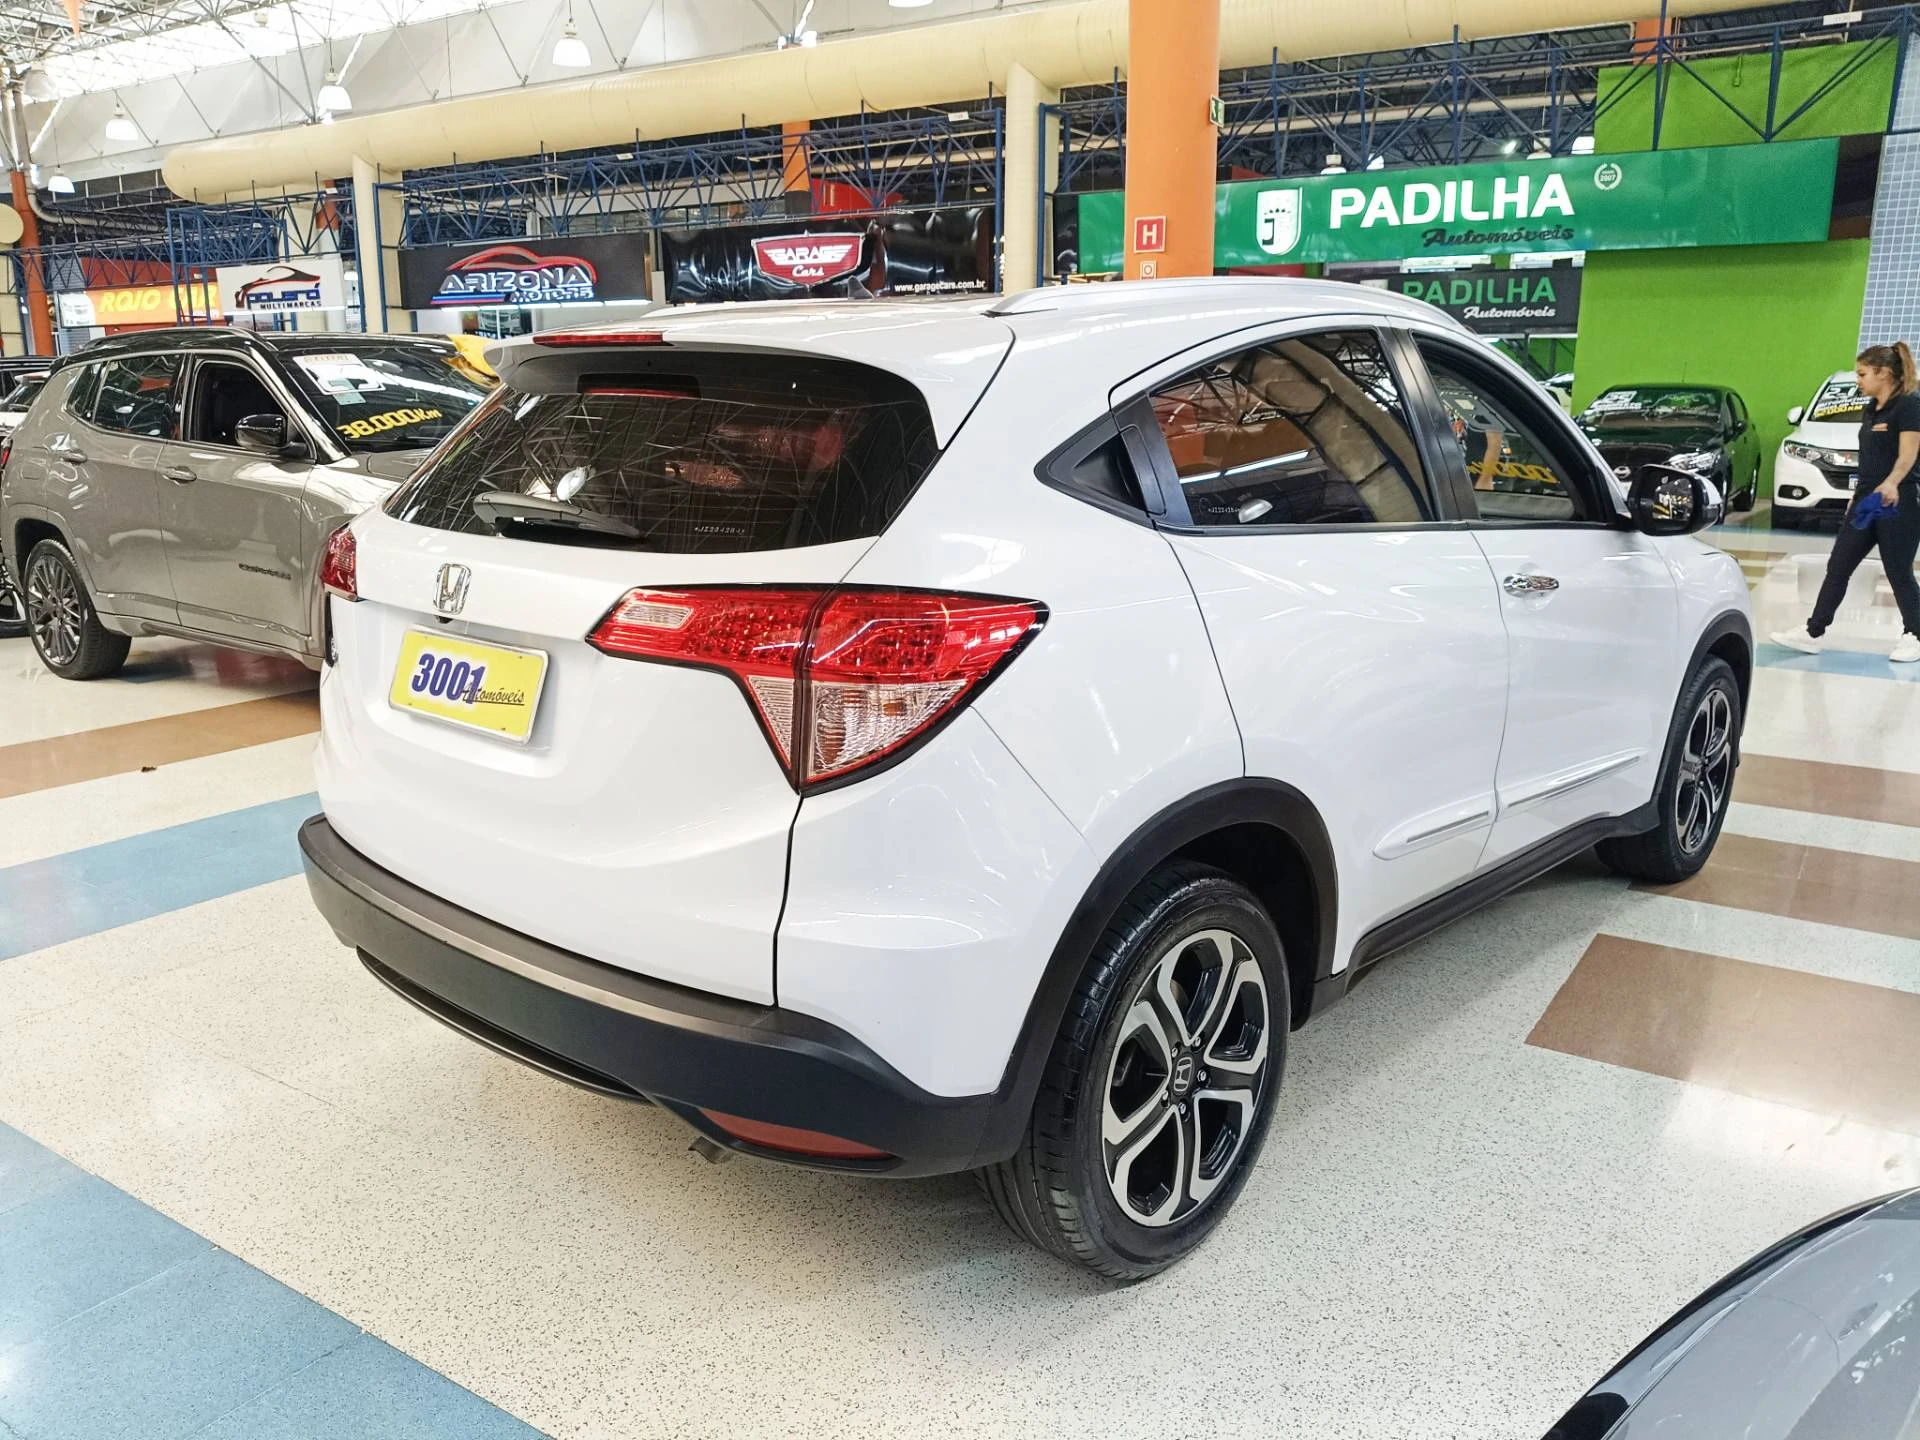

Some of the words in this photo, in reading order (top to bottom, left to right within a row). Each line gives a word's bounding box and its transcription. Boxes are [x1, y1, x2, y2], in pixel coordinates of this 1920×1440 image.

[1329, 173, 1575, 229] PADILHA
[1142, 223, 1158, 246] H
[1422, 223, 1576, 248] Automóveis
[763, 244, 853, 266] GARAGE
[438, 265, 593, 295] ARIZONA
[792, 264, 825, 277] Cars
[510, 286, 595, 302] MOTORS
[894, 278, 986, 293] www.garagecars.com.br
[1402, 276, 1557, 305] PADILHA
[99, 288, 162, 313] ROJO
[260, 300, 322, 310] MULTIMARCAS
[1463, 305, 1557, 320] Automóveis
[336, 407, 443, 439] 38.000Km
[411, 652, 487, 705] 3001
